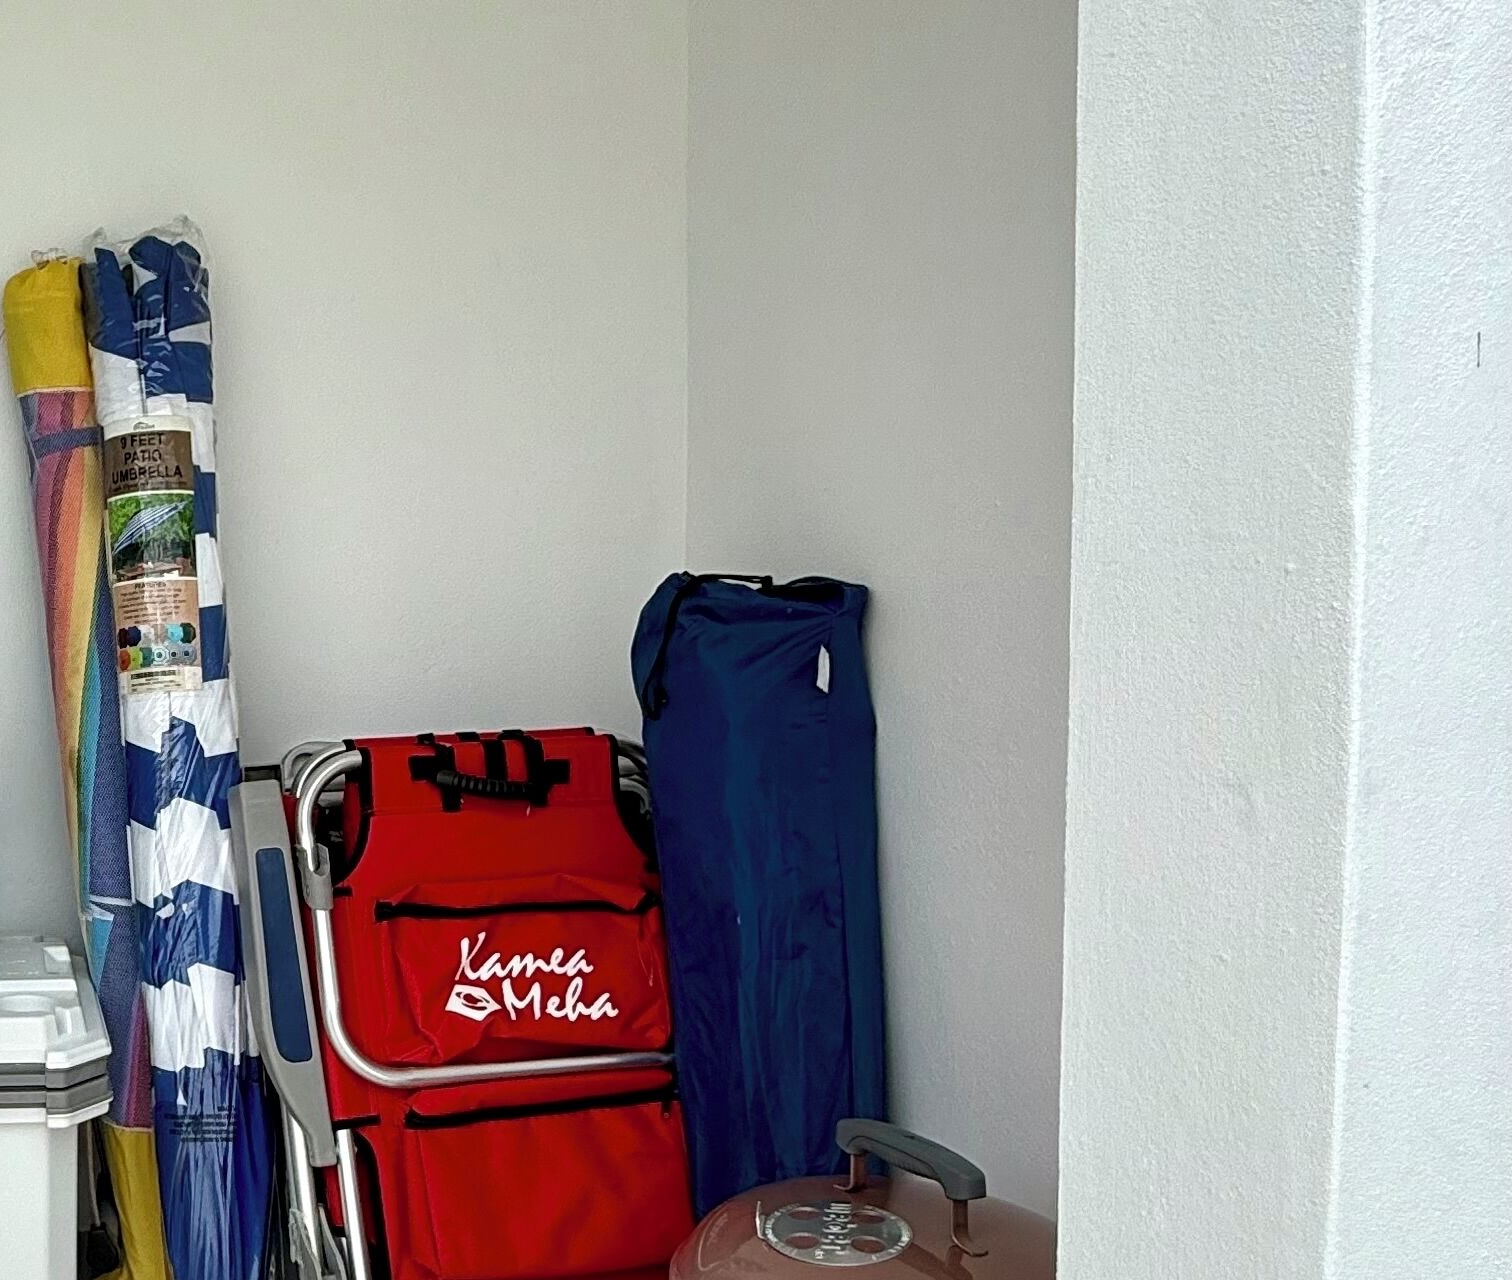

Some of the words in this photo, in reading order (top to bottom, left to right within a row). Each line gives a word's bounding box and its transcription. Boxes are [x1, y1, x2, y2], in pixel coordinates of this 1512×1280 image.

[130, 432, 164, 448] FEET
[124, 448, 162, 465] PATIO
[111, 464, 183, 485] UMBRELLA
[454, 931, 594, 981] Kamea
[501, 976, 620, 1022] Meha
